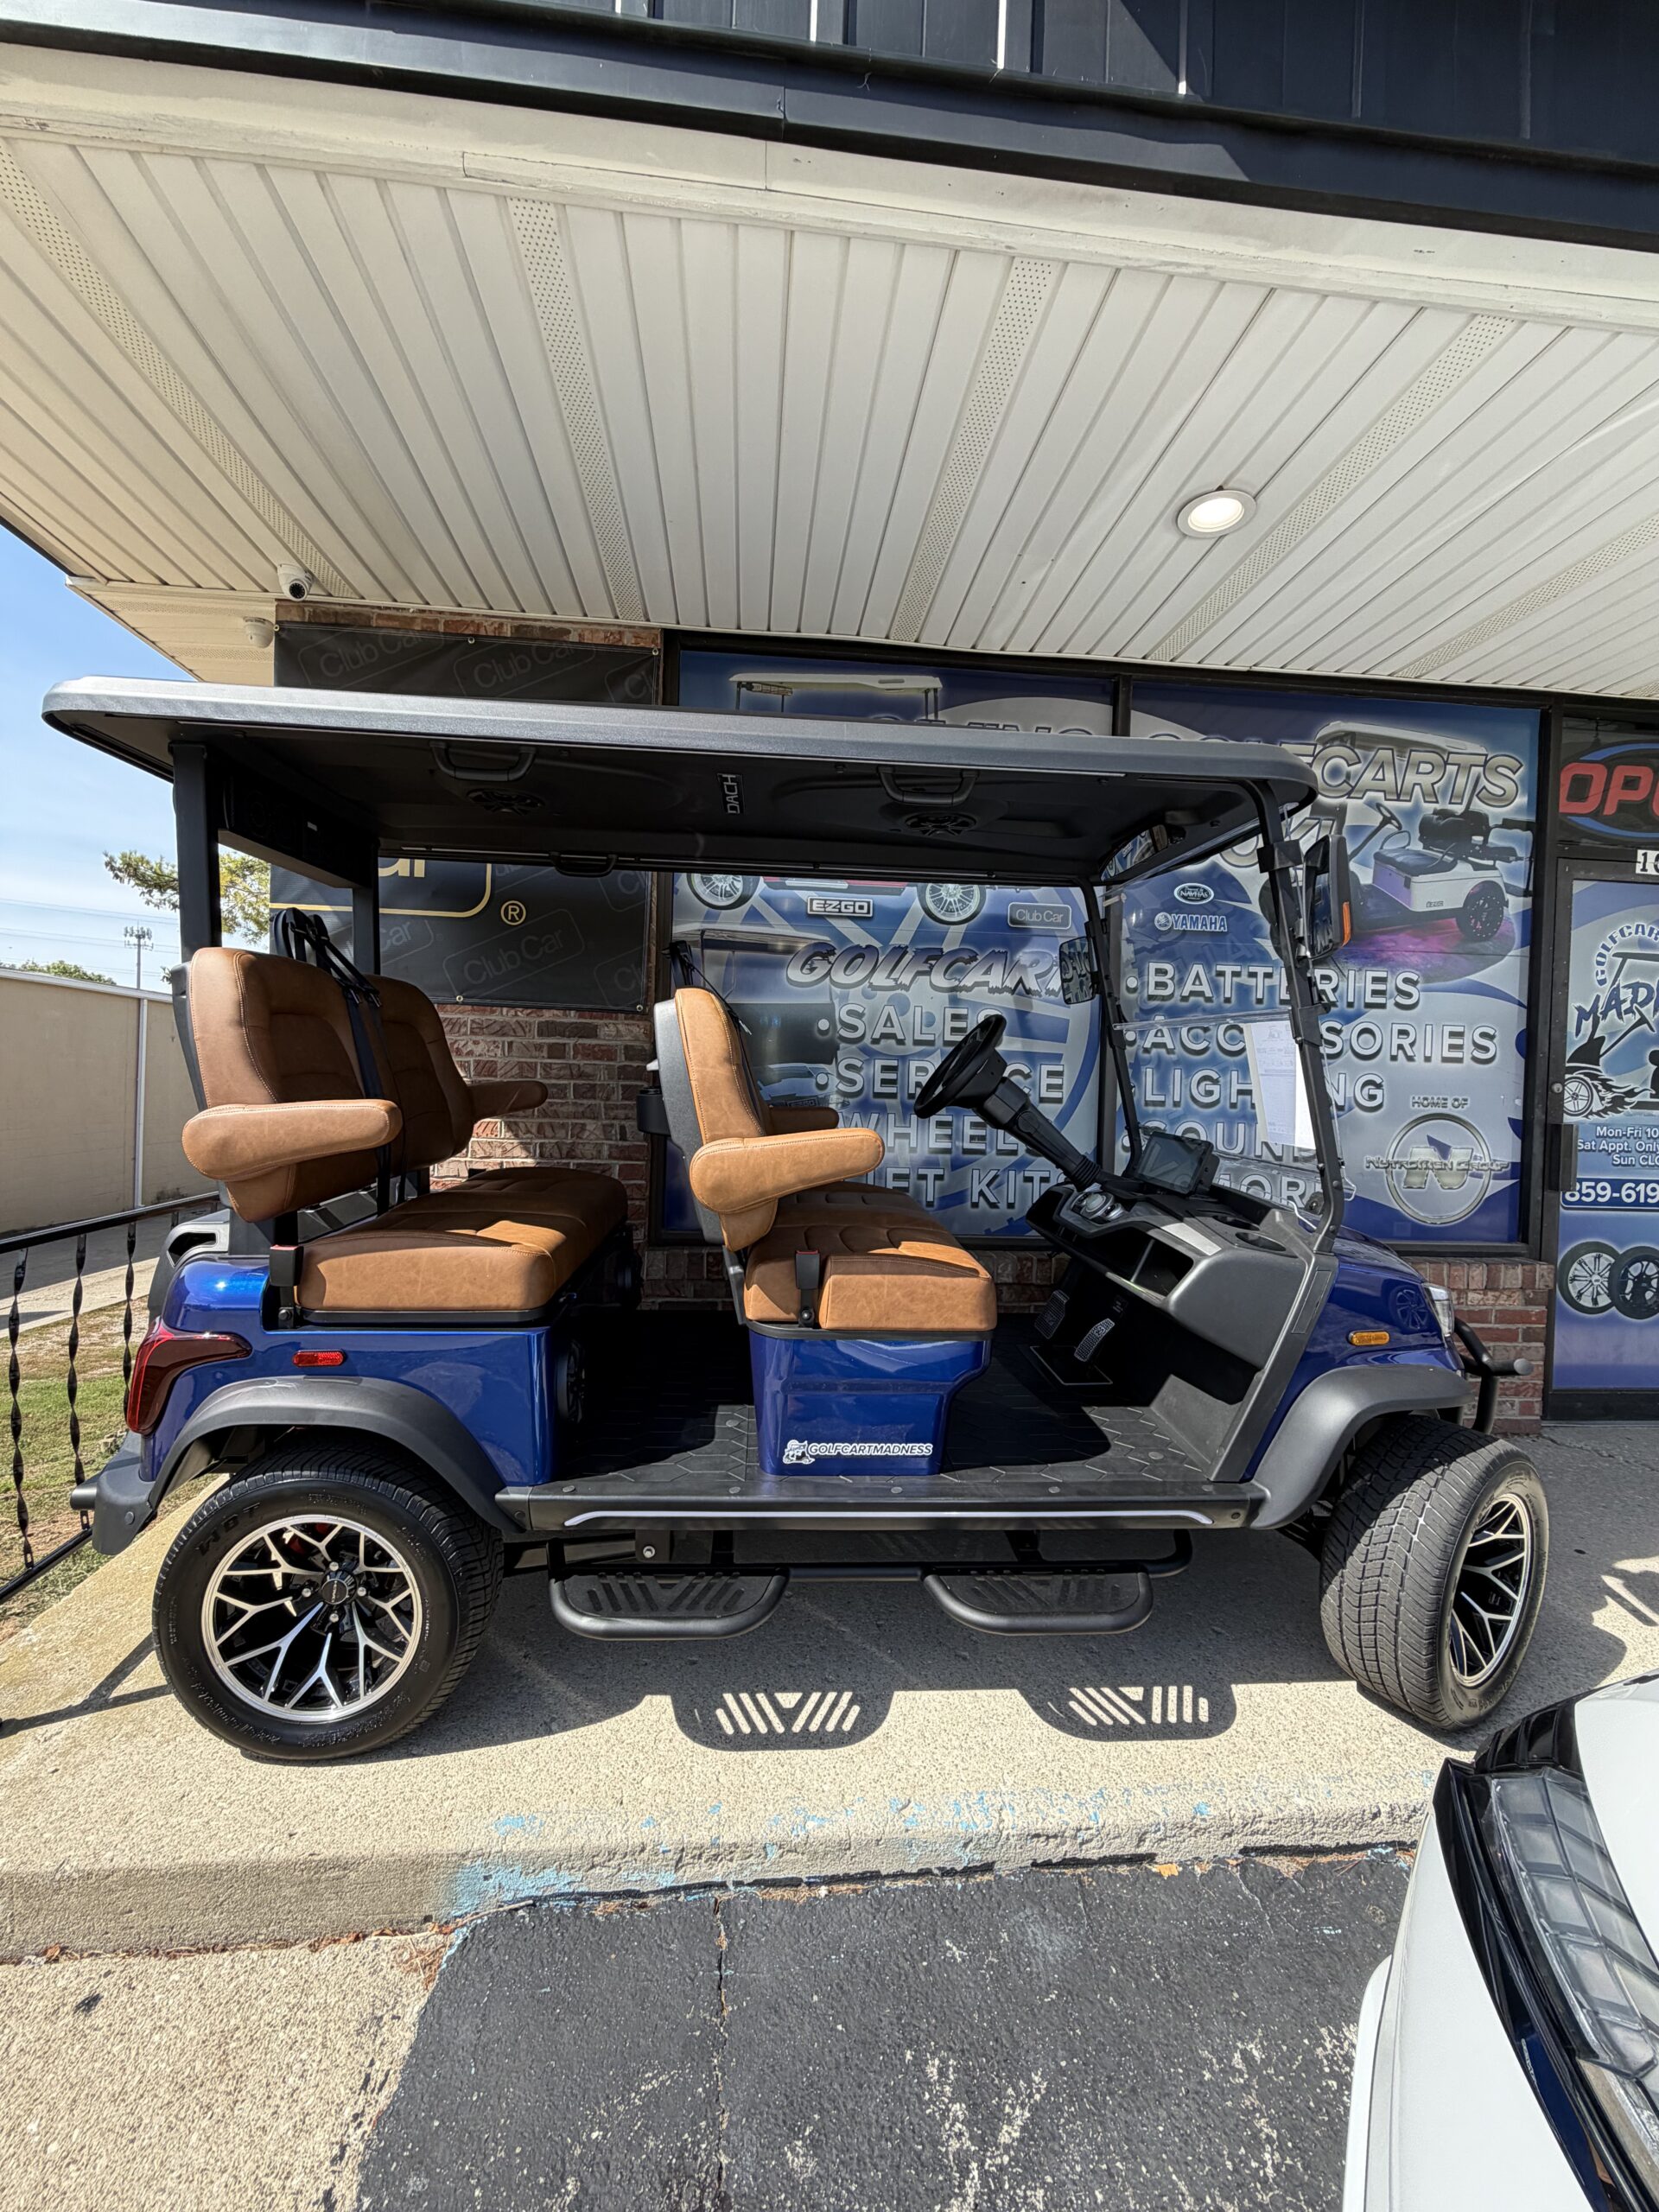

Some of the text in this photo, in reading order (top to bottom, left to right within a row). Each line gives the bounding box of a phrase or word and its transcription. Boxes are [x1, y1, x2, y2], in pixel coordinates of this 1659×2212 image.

[320, 640, 378, 677] Club
[474, 652, 531, 688] Club
[722, 774, 741, 814] DACH
[1559, 762, 1659, 817] OP
[1015, 909, 1064, 925] Club Car
[1171, 913, 1228, 932] YAMAHA
[463, 929, 564, 985] Club Car
[1573, 979, 1659, 1039] MAD
[1143, 1014, 1497, 1065] ACCSORIES
[836, 1057, 1065, 1103] SERCE
[1144, 1067, 1385, 1111] LIGHNG
[1412, 1096, 1469, 1109] HOME OF
[1577, 1139, 1596, 1150] Sat
[1599, 1141, 1631, 1153] Appt.
[1596, 1126, 1642, 1137] Mon-Fri
[1612, 1154, 1635, 1165] Sun
[971, 1168, 1066, 1210] KIT
[809, 1443, 933, 1456] GOLFCARTMADNESS
